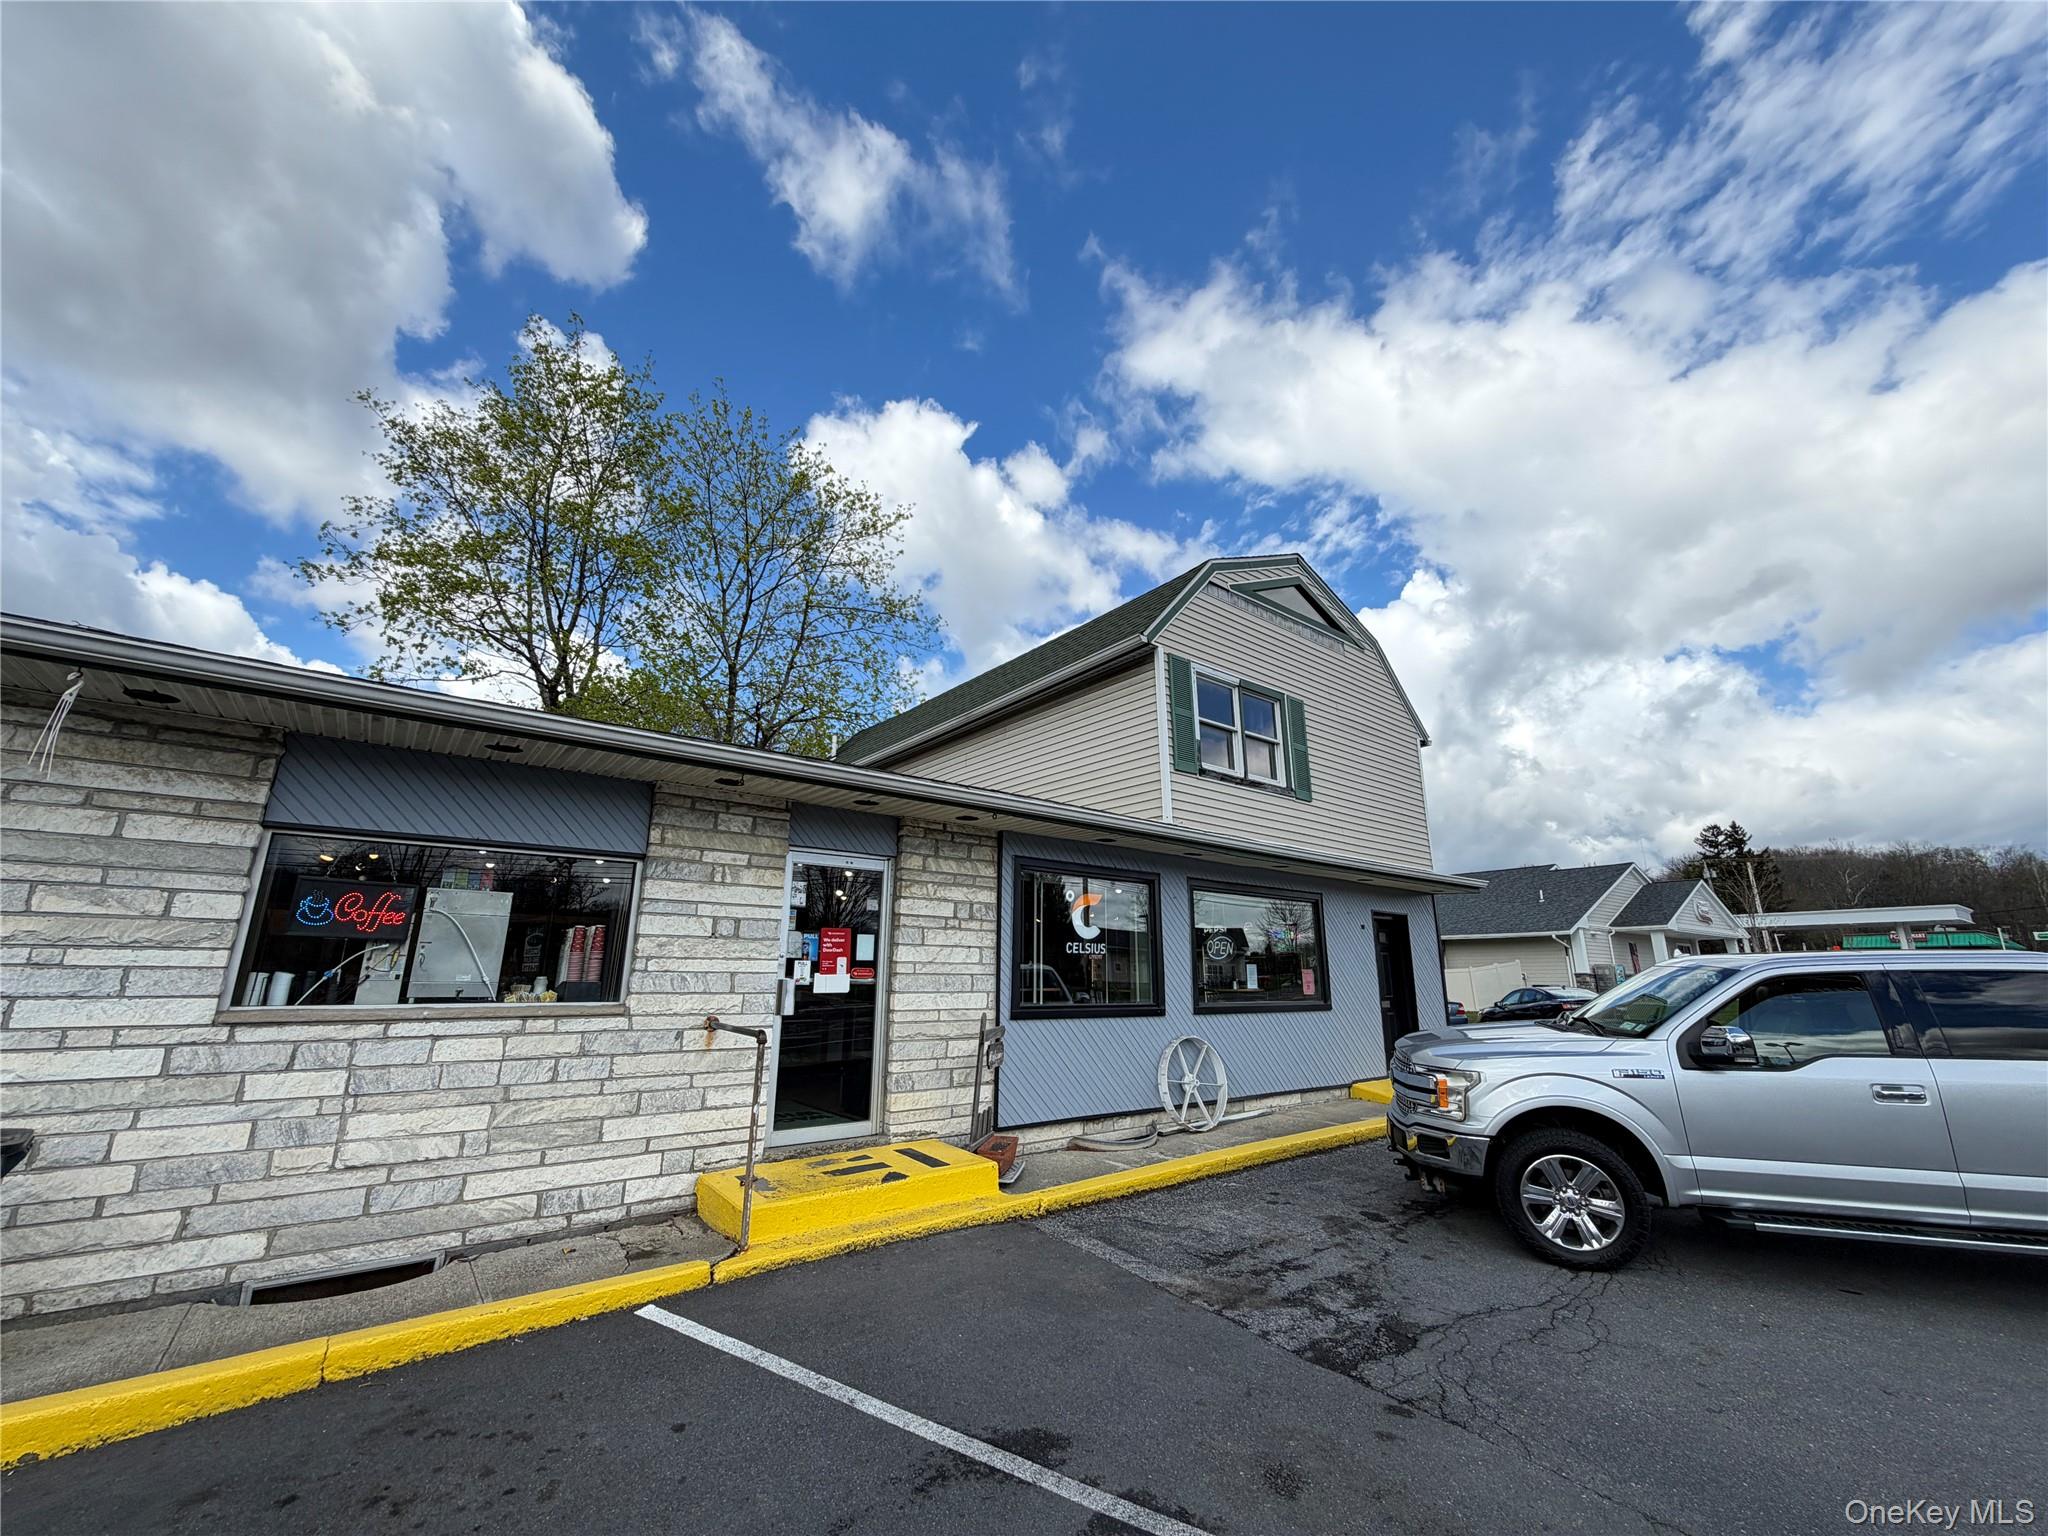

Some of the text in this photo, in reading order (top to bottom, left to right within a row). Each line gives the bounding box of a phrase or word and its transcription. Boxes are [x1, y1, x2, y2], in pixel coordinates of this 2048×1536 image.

[334, 891, 406, 932] Coffee
[1065, 942, 1106, 955] CELSIUS
[1206, 940, 1234, 955] OPEN
